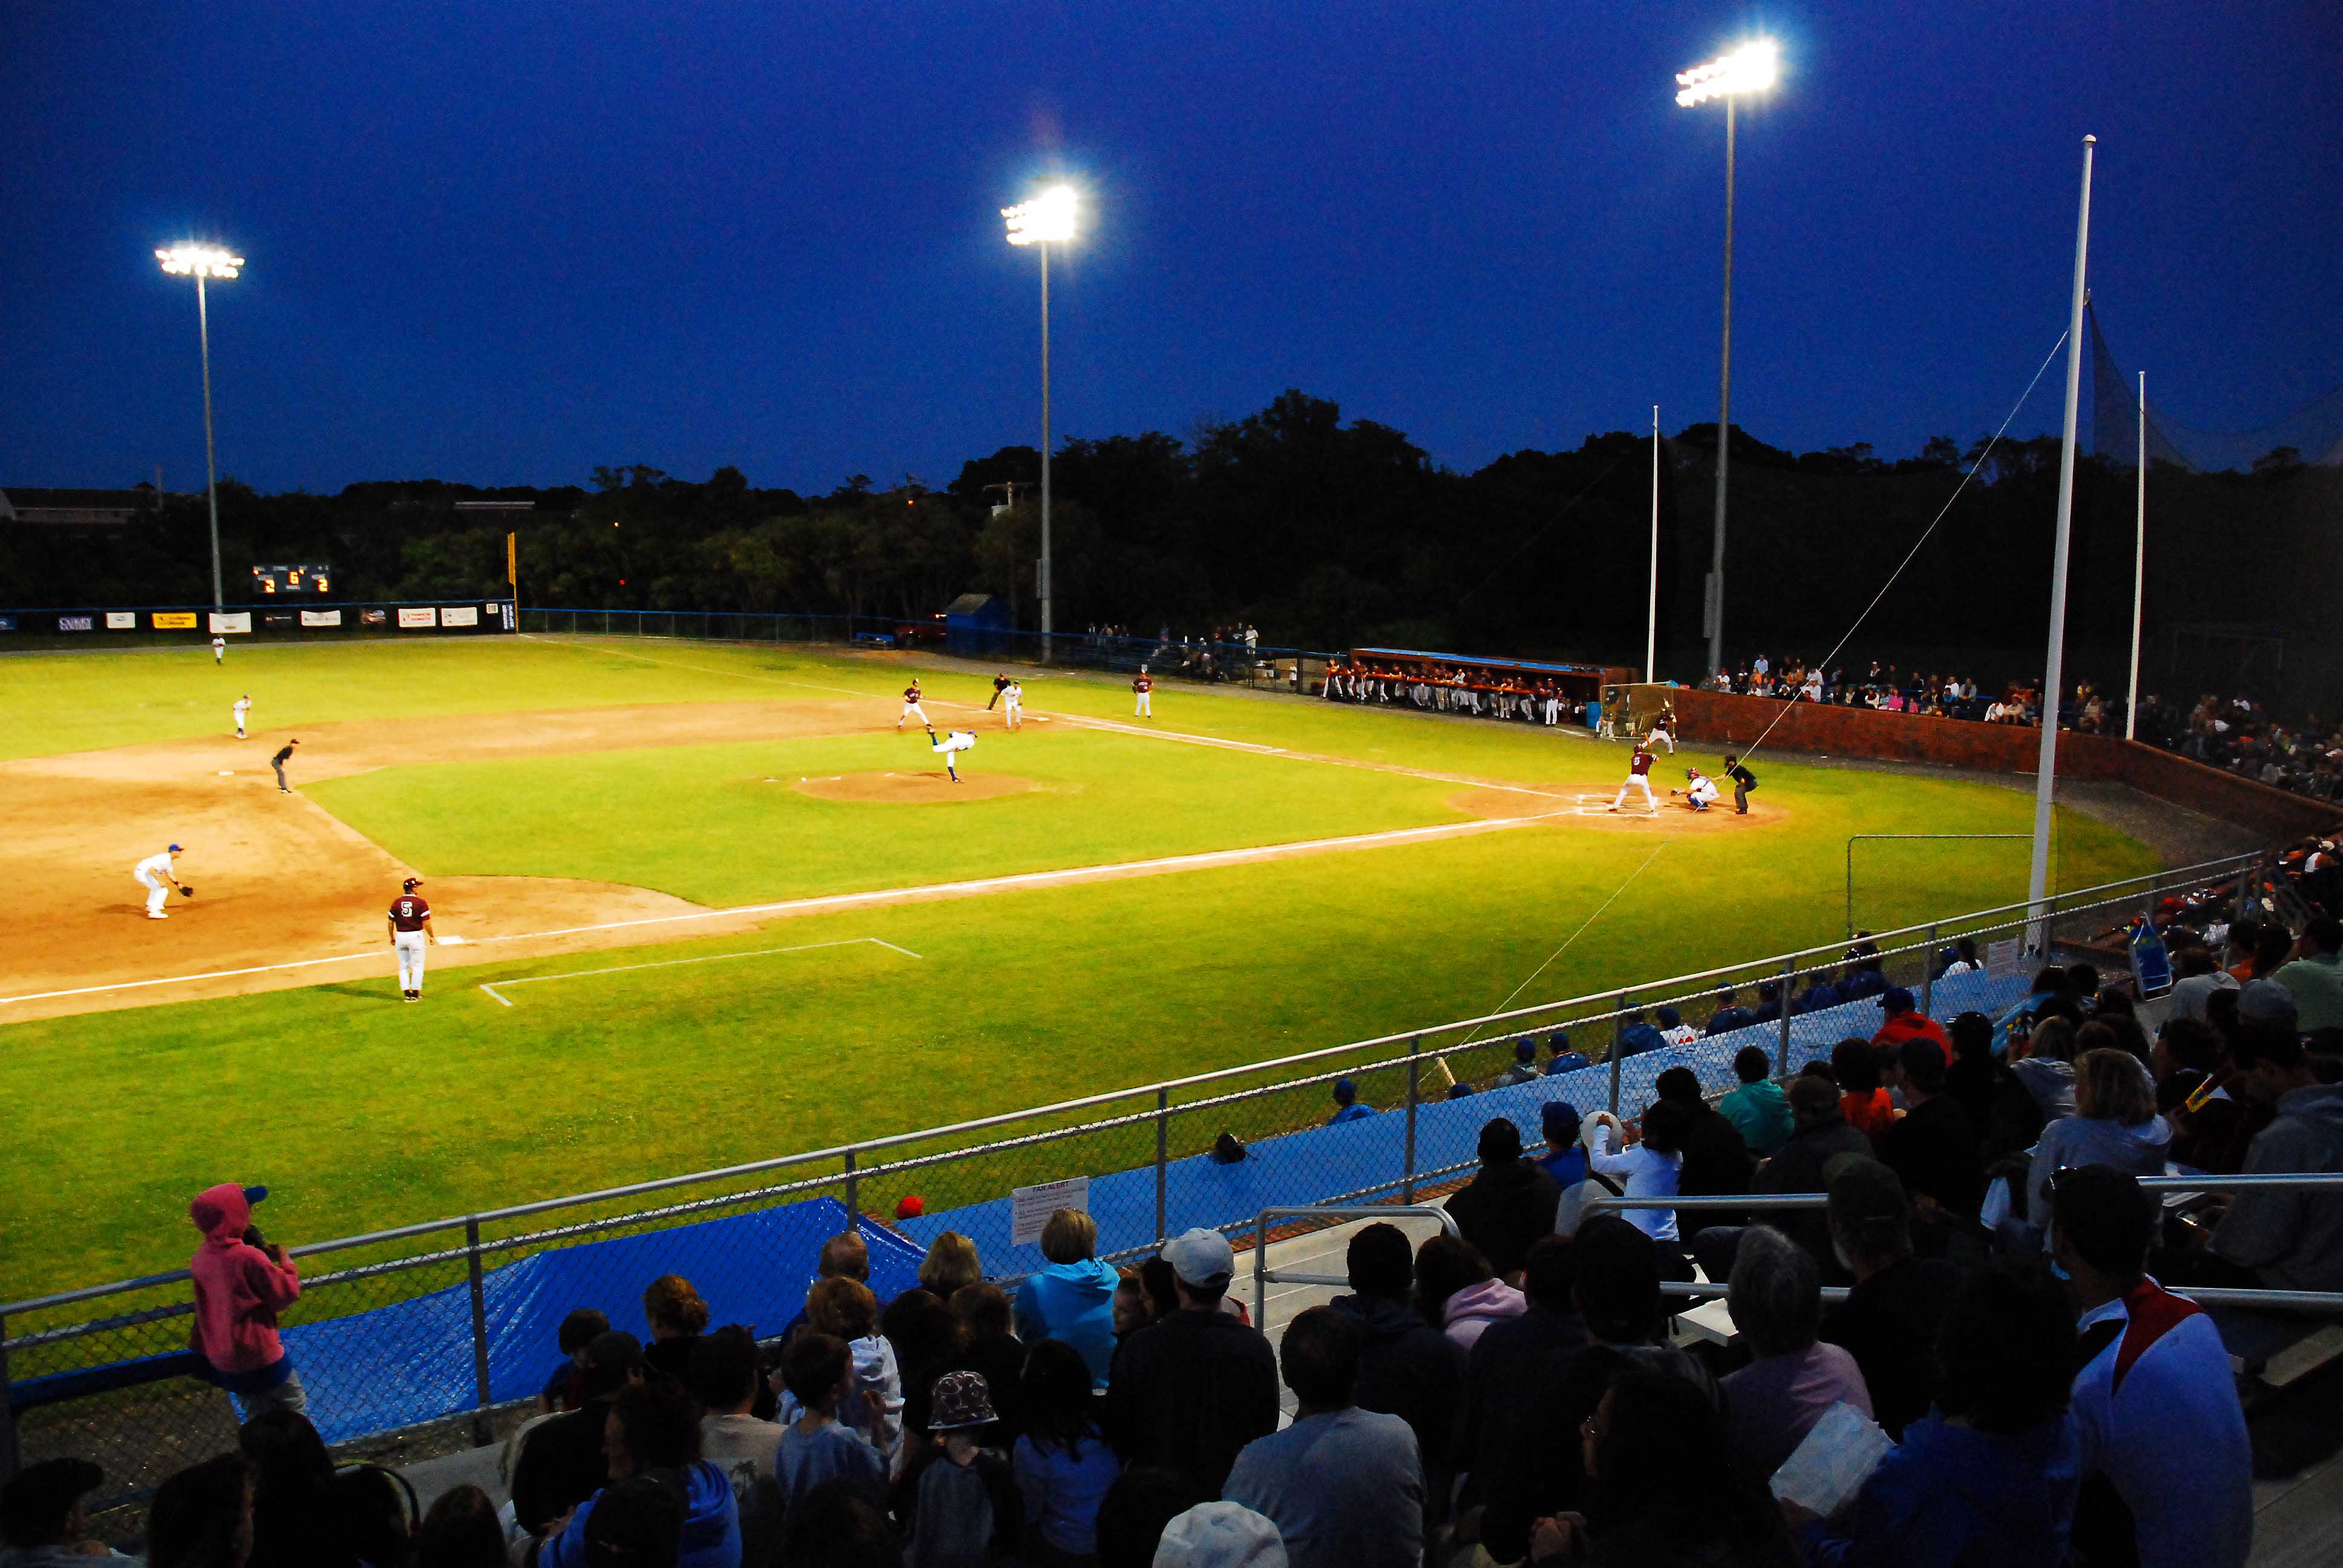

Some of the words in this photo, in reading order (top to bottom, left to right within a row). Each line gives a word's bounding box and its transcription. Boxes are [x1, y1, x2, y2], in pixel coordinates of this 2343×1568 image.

[289, 571, 299, 585] 6
[318, 578, 328, 592] 2
[264, 578, 275, 593] 2
[401, 901, 413, 917] 5
[1047, 1181, 1069, 1190] ALERT
